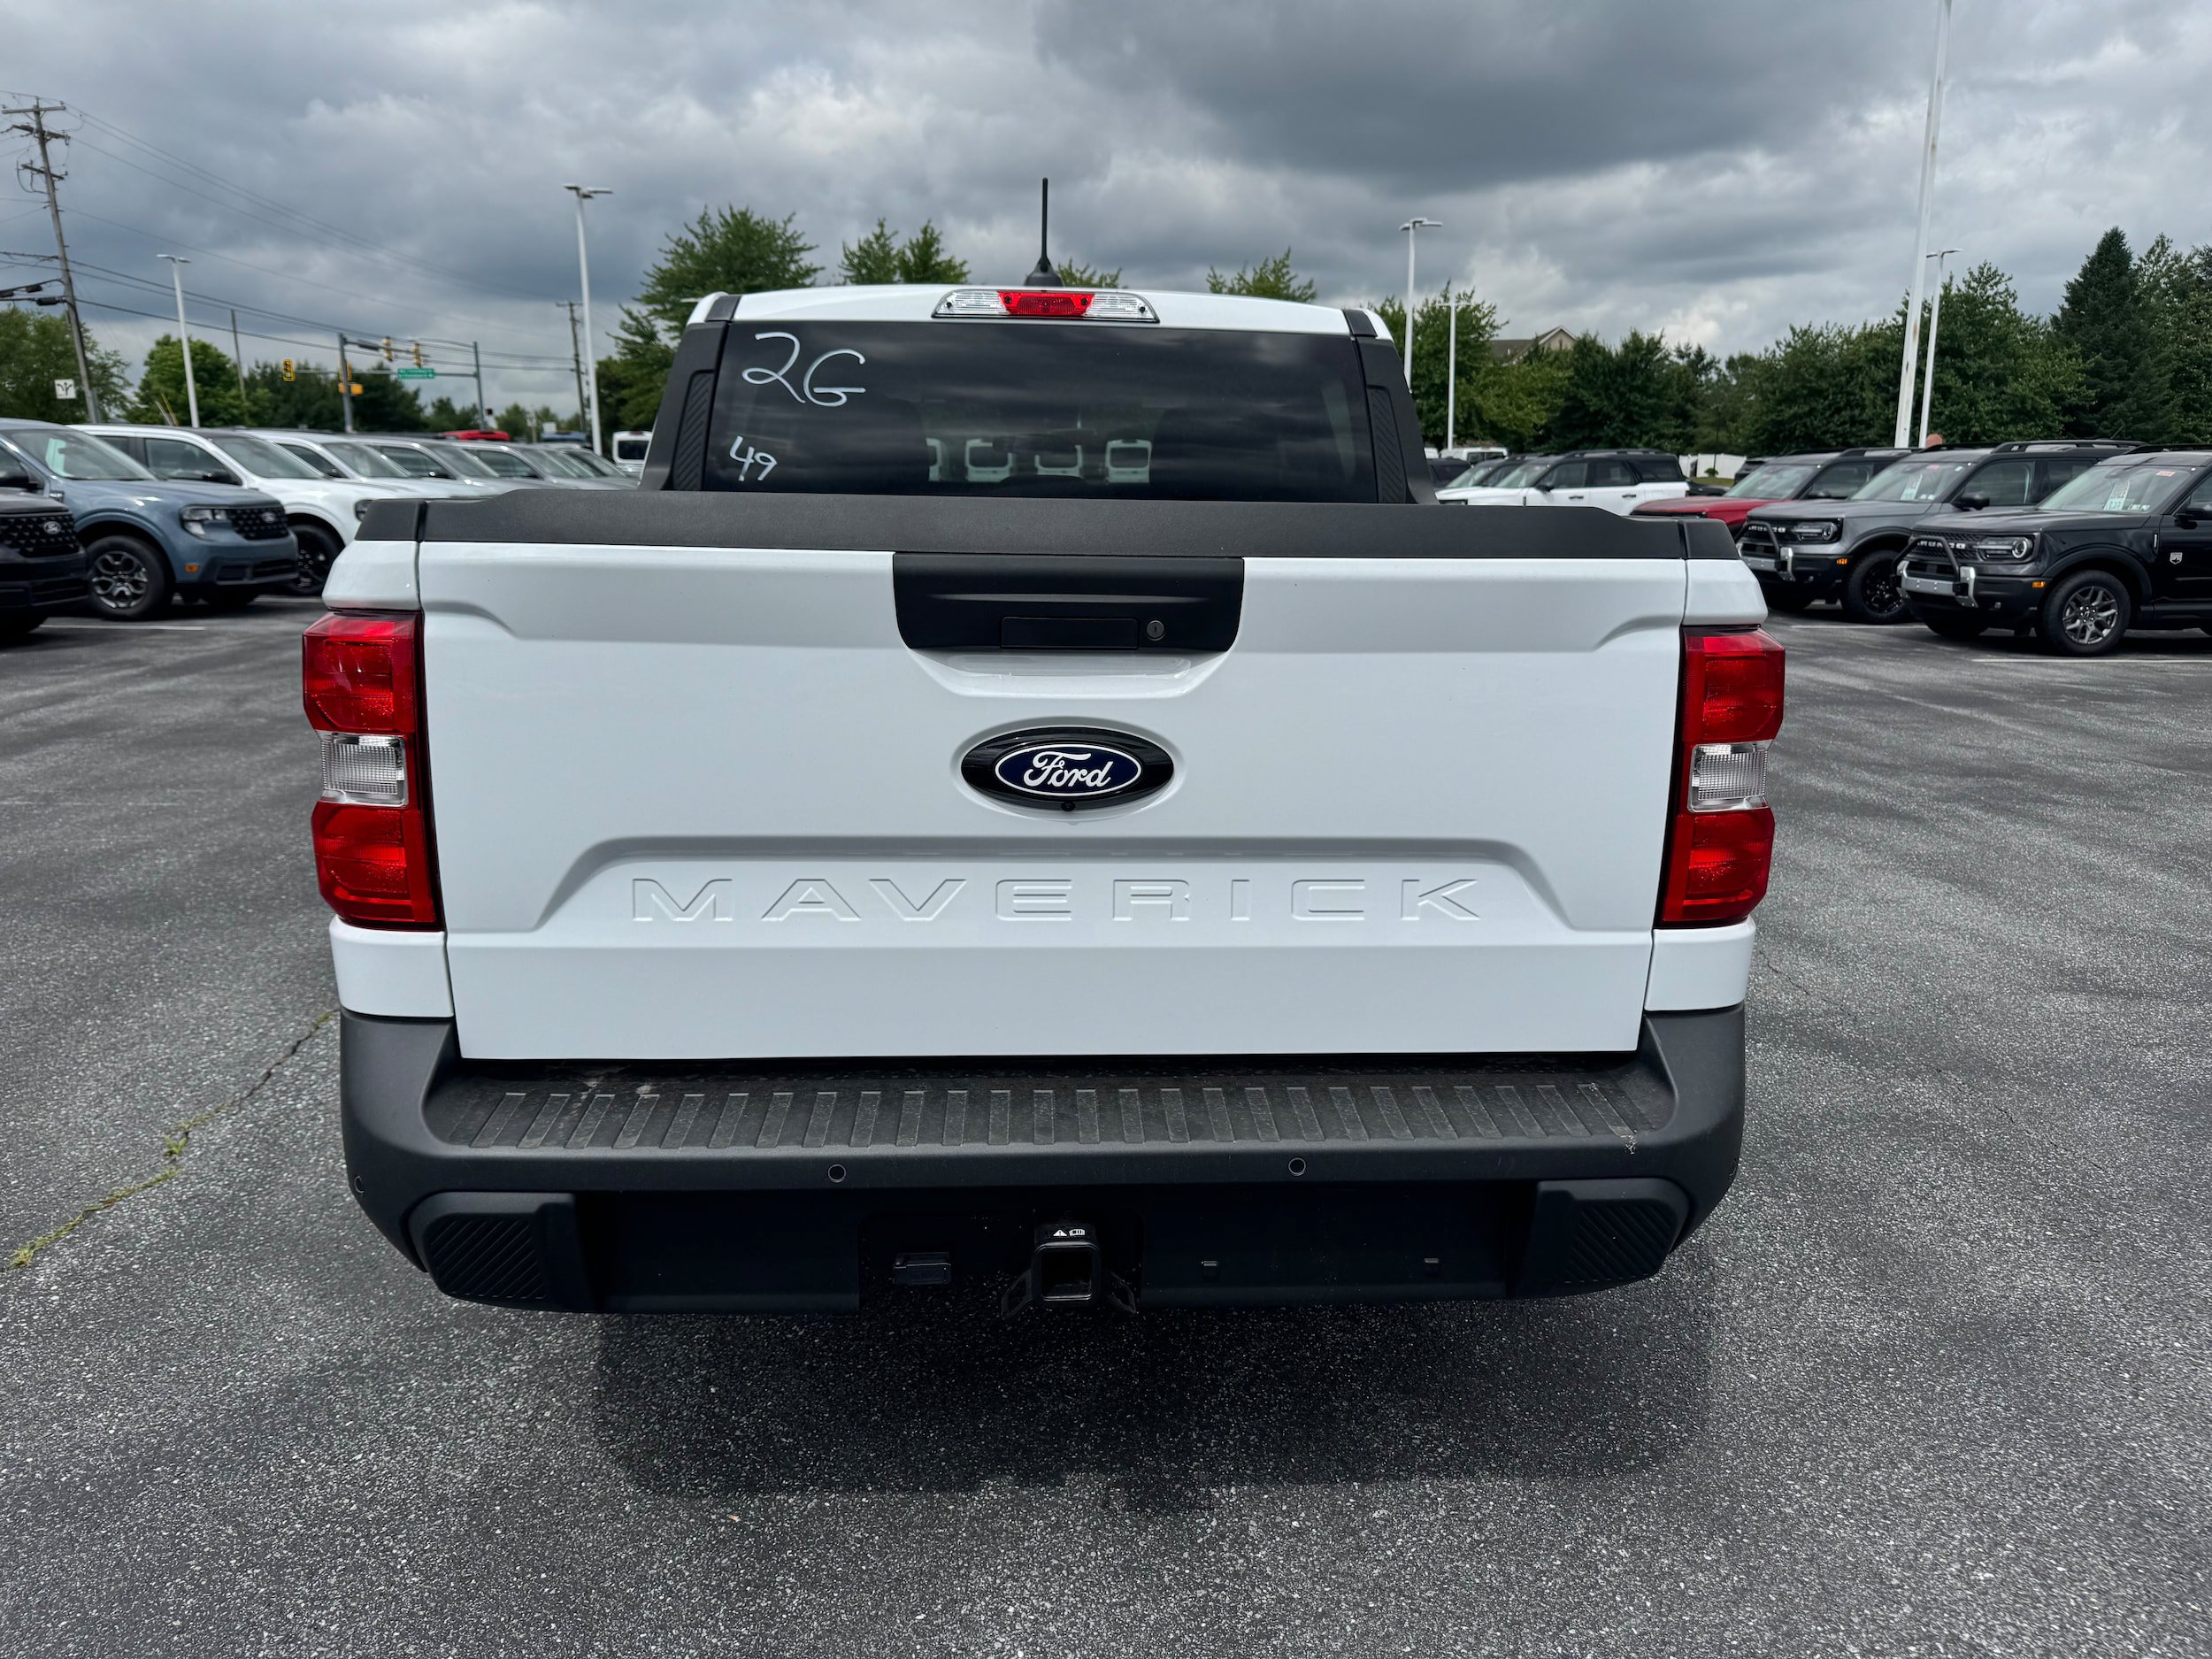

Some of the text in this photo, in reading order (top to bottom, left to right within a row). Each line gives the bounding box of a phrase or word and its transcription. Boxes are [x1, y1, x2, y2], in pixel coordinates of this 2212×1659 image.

[729, 435, 778, 481] 49
[1023, 750, 1114, 787] Ford
[633, 879, 1480, 921] MAVERICK
